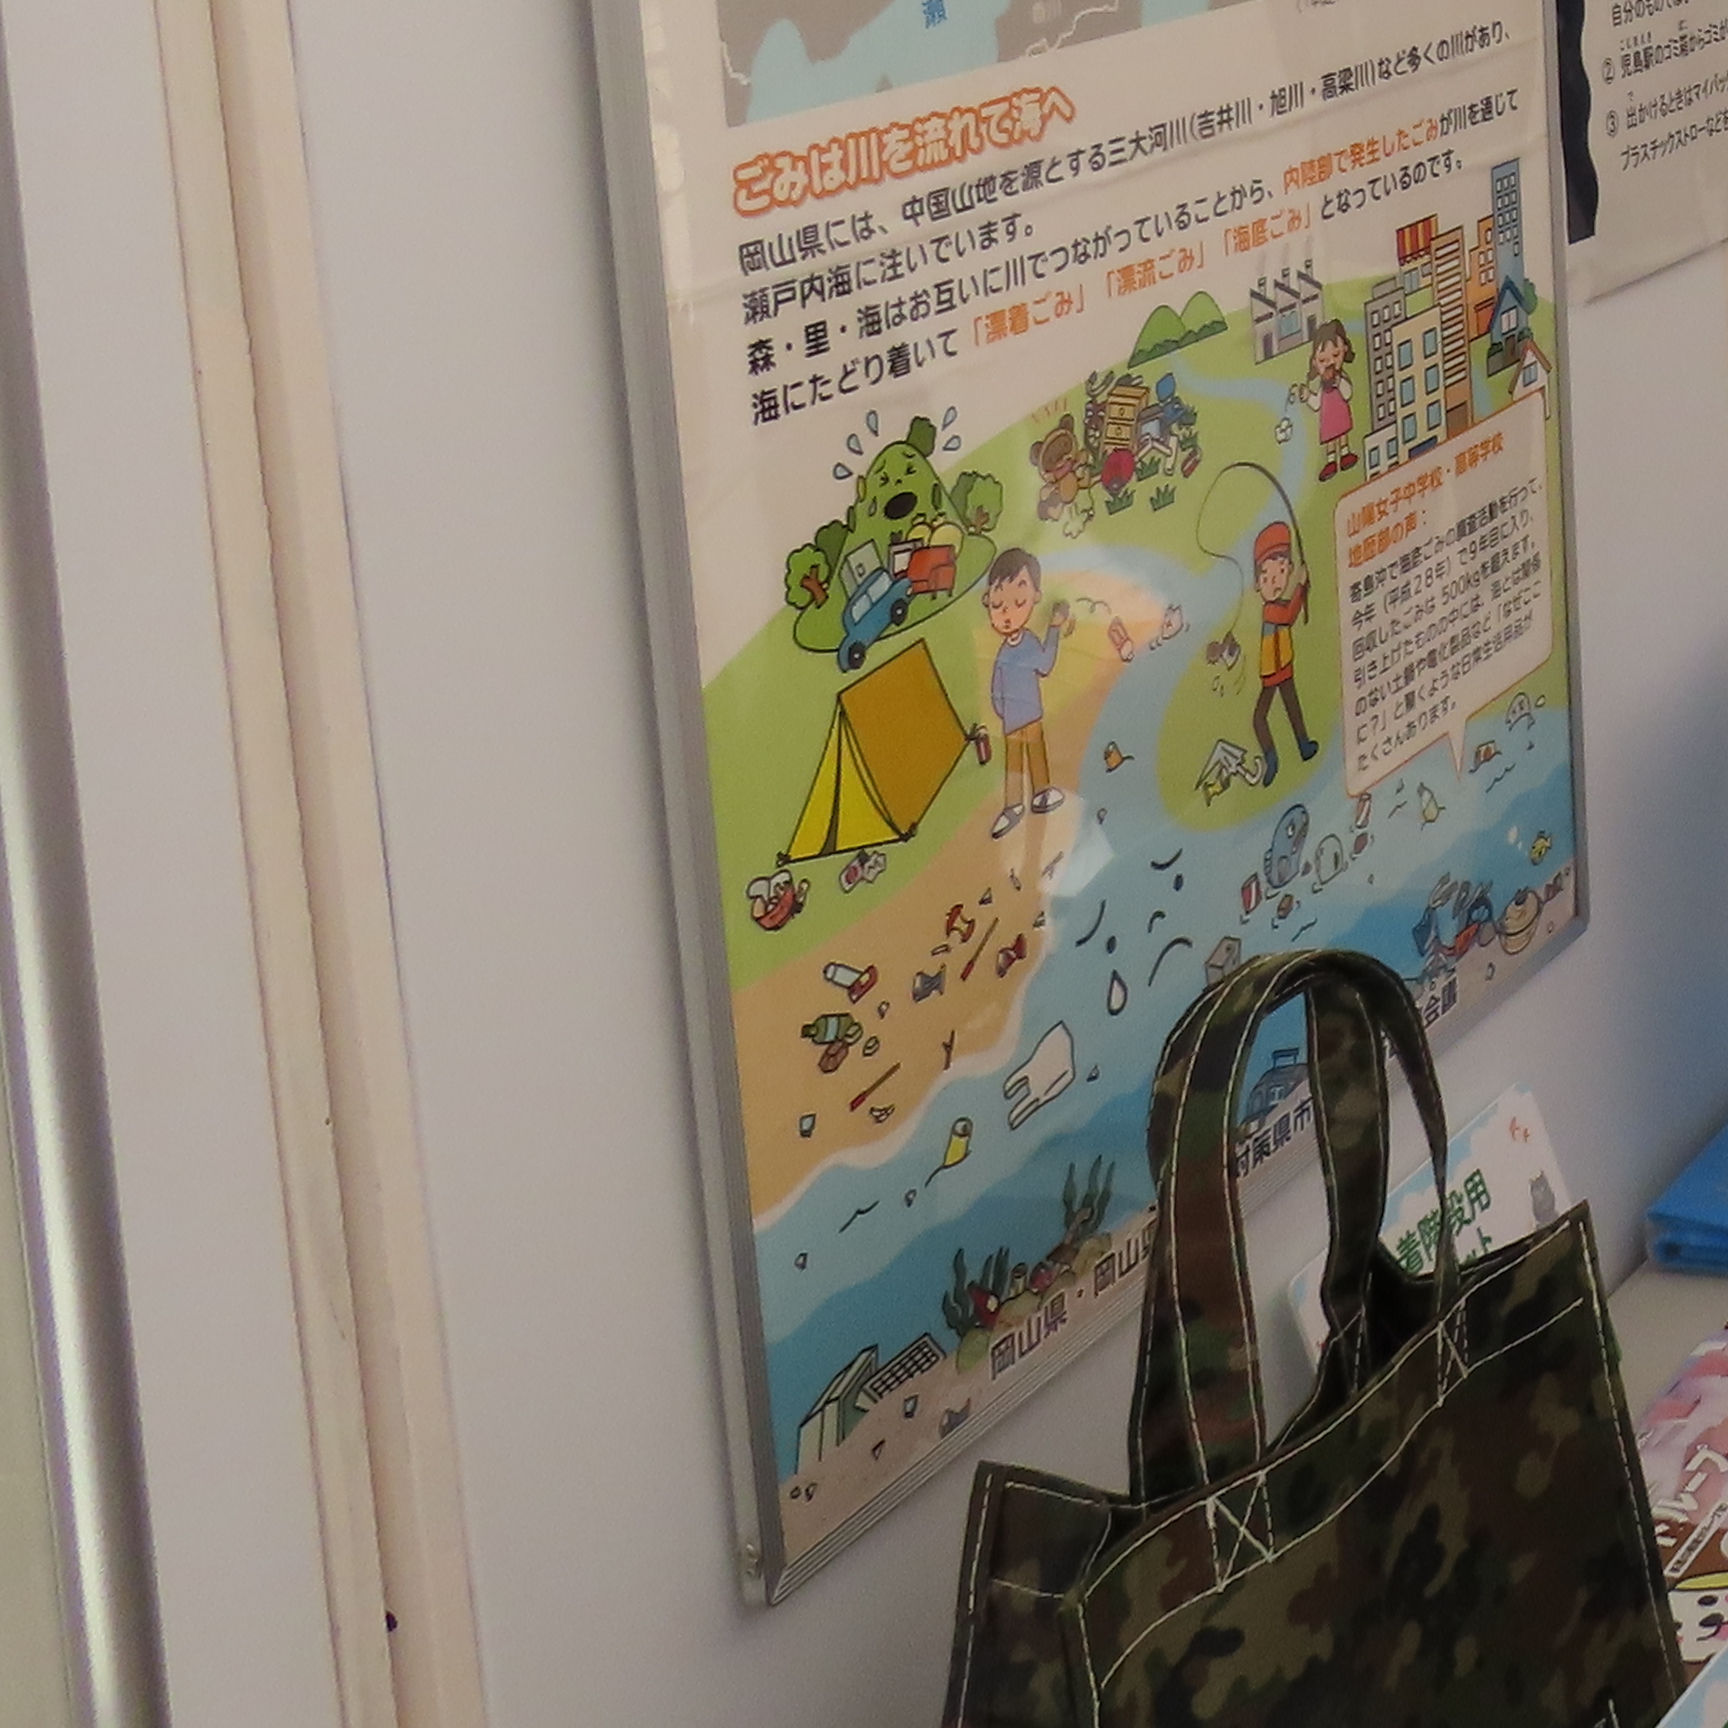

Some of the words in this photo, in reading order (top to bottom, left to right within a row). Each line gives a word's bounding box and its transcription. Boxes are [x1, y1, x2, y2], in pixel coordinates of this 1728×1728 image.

[732, 87, 1075, 216] ごみは川を流れて海へ
[743, 221, 1034, 325] 瀬戸内海に注いでいます。
[1357, 694, 1457, 772] たくさんあります。
